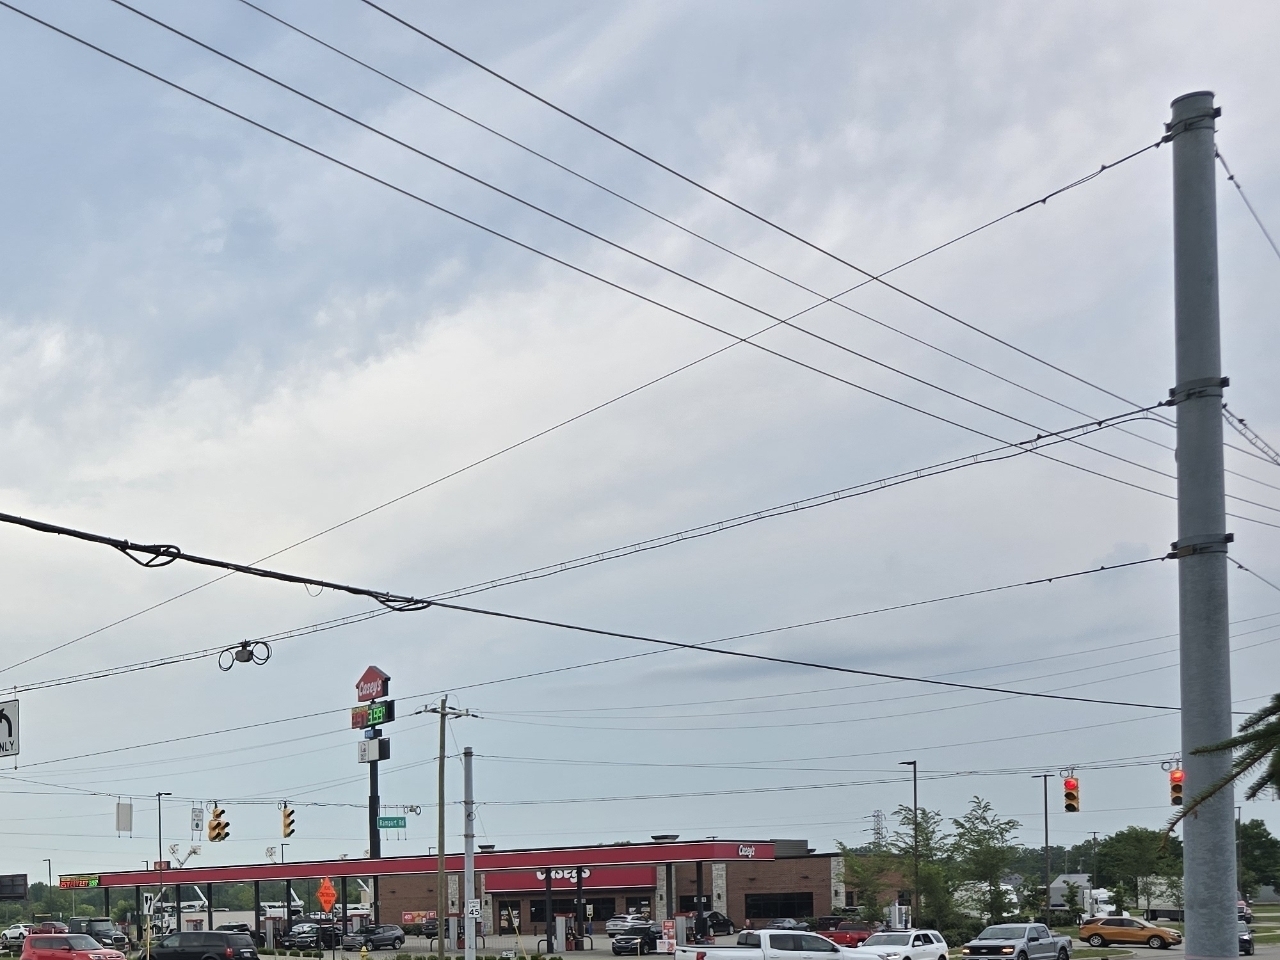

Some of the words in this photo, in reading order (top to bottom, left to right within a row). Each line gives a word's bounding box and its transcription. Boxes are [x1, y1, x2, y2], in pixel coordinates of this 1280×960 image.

[359, 678, 382, 696] Casey's
[738, 844, 755, 858] Casey's
[468, 908, 480, 916] 45
